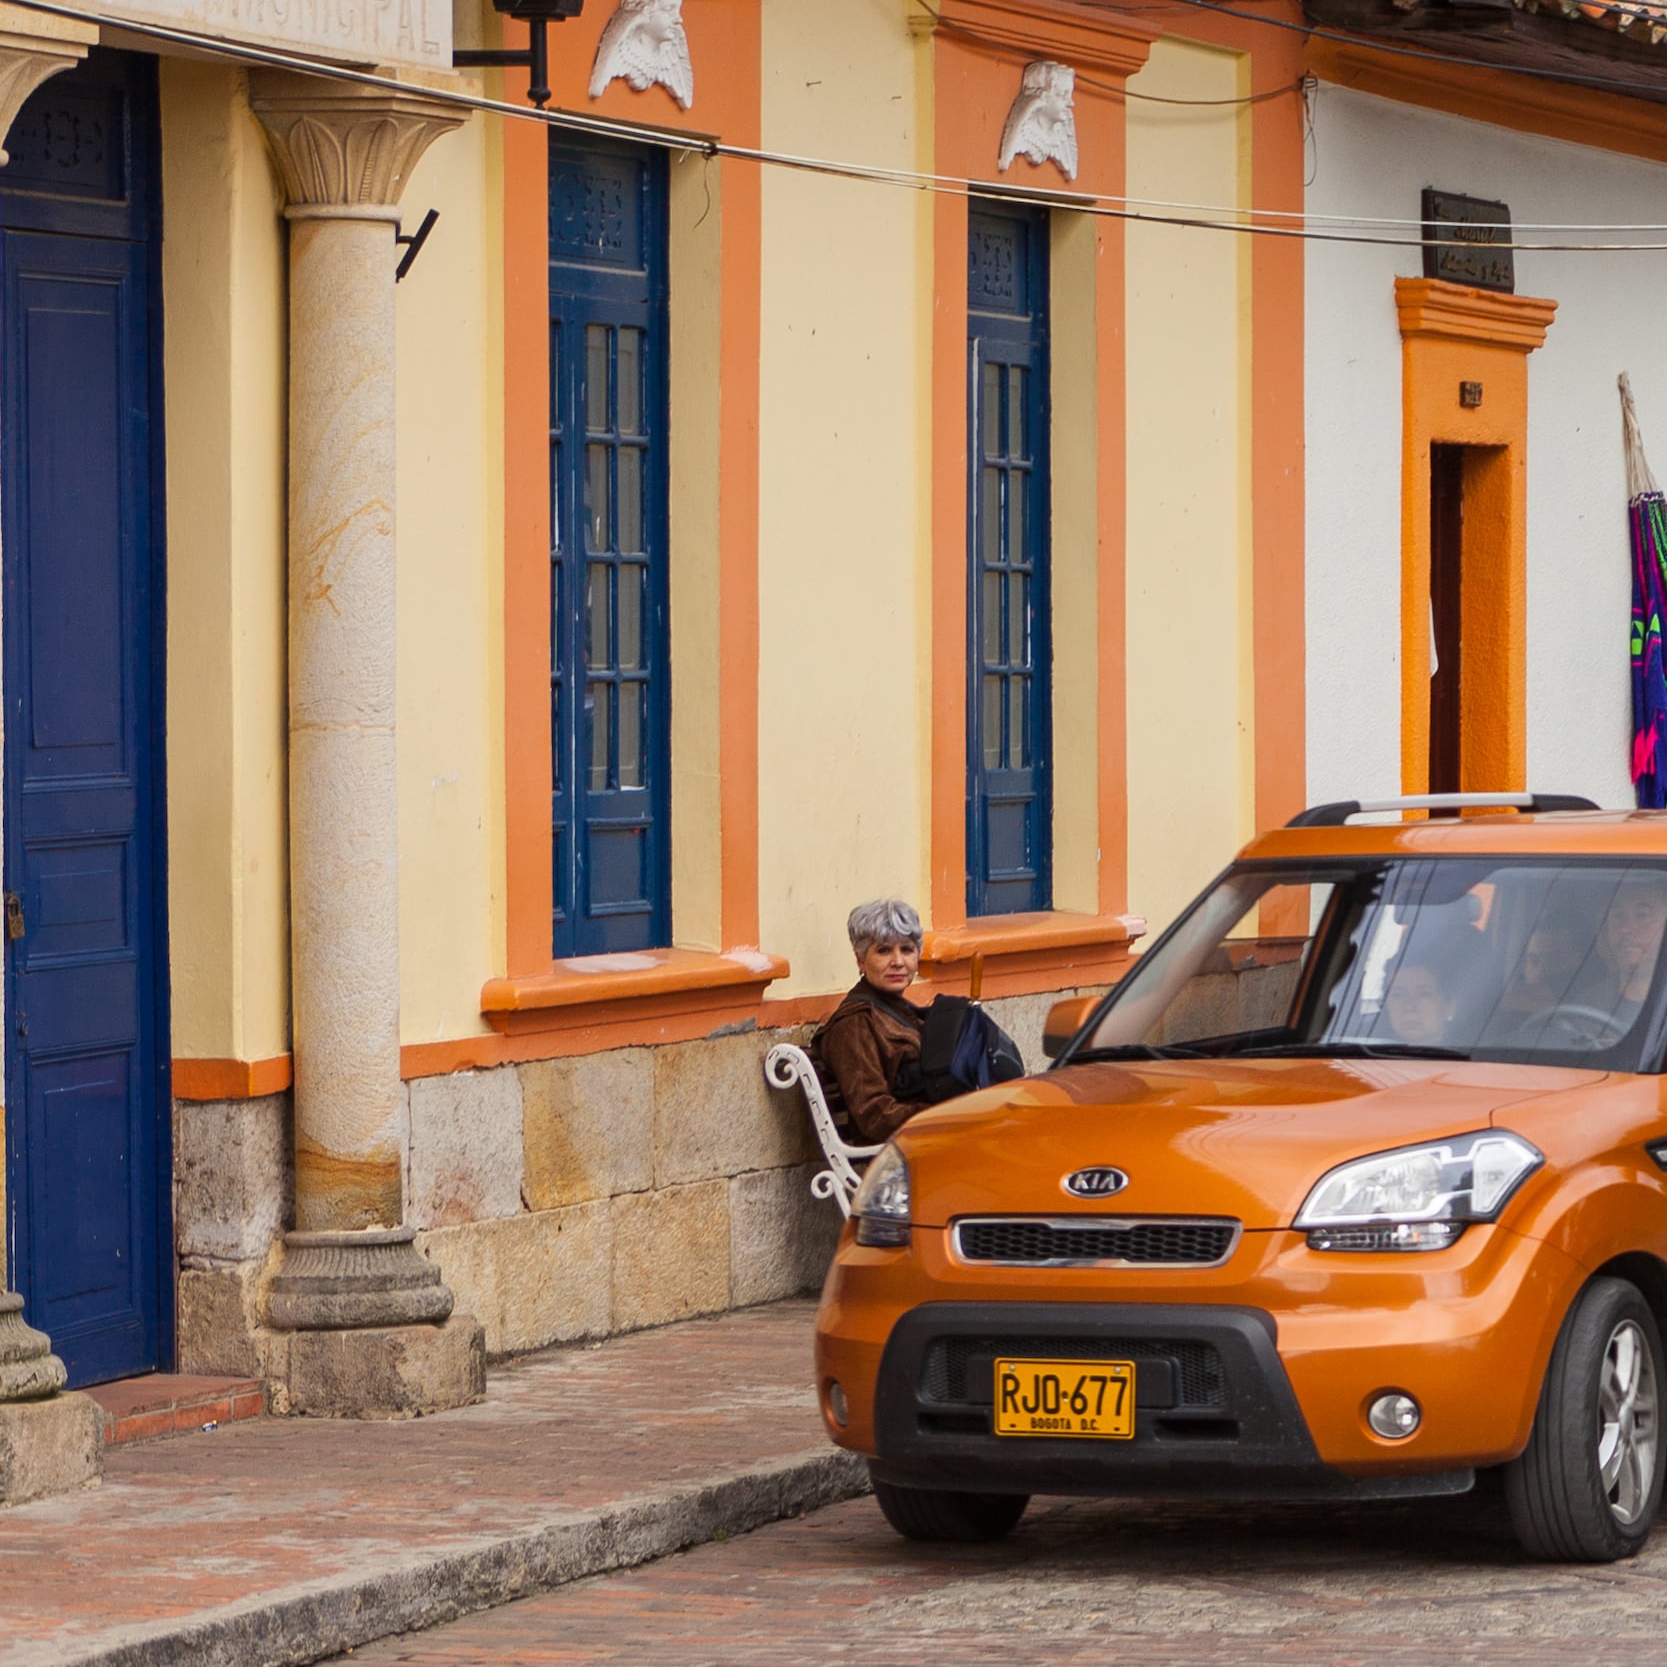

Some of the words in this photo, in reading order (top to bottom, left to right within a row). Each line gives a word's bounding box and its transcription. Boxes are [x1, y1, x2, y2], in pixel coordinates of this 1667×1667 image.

[1074, 1172, 1116, 1190] KIA
[1030, 1417, 1072, 1430] BOGOTA
[1080, 1419, 1101, 1431] D.C.
